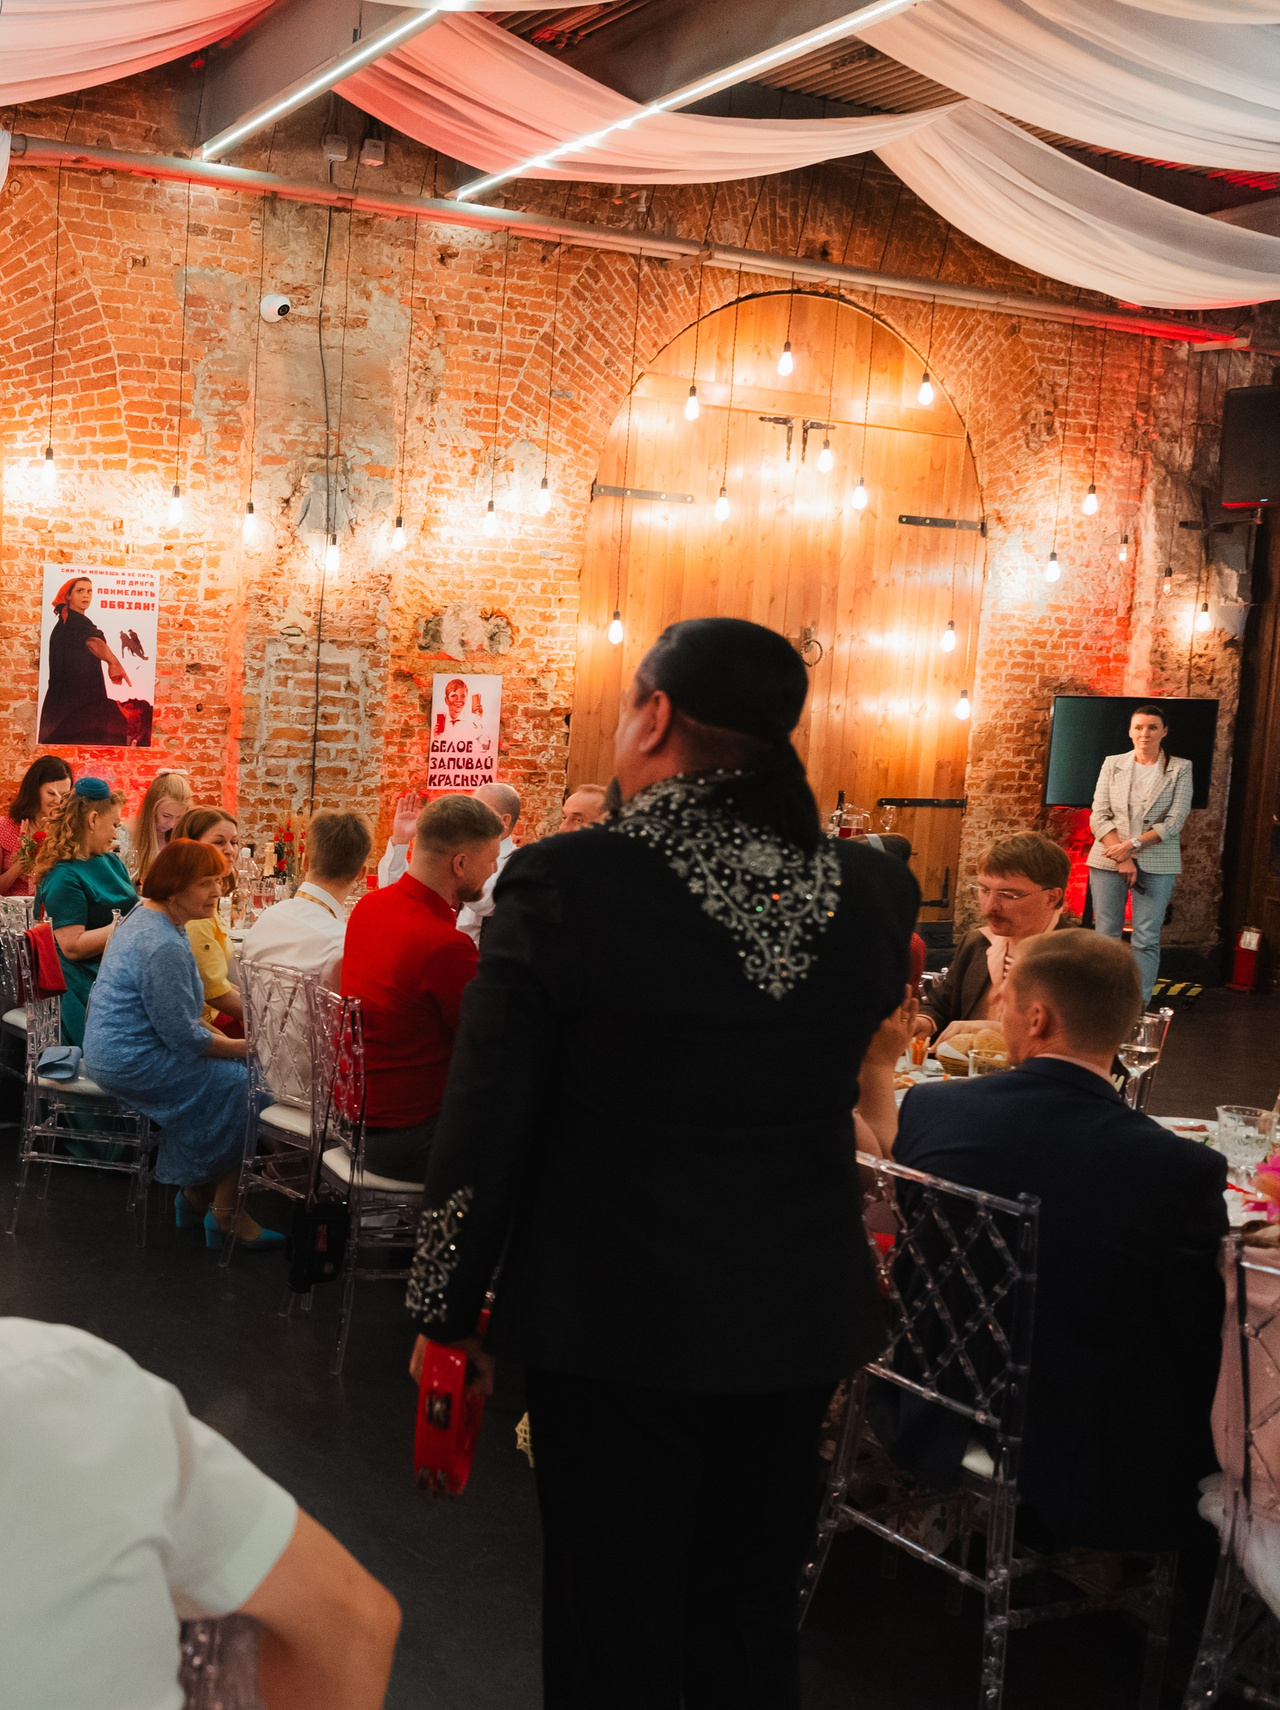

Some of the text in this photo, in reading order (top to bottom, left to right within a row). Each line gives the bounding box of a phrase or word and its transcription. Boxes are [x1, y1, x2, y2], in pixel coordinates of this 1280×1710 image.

[97, 587, 156, 597] ПОХМЕЛИТЬ
[100, 600, 156, 611] ОБЯЗАН!
[431, 740, 473, 753] БЕЛОЕ
[429, 756, 494, 770] ЗАПИВАЙ
[428, 774, 493, 787] КРАСНЫМ
